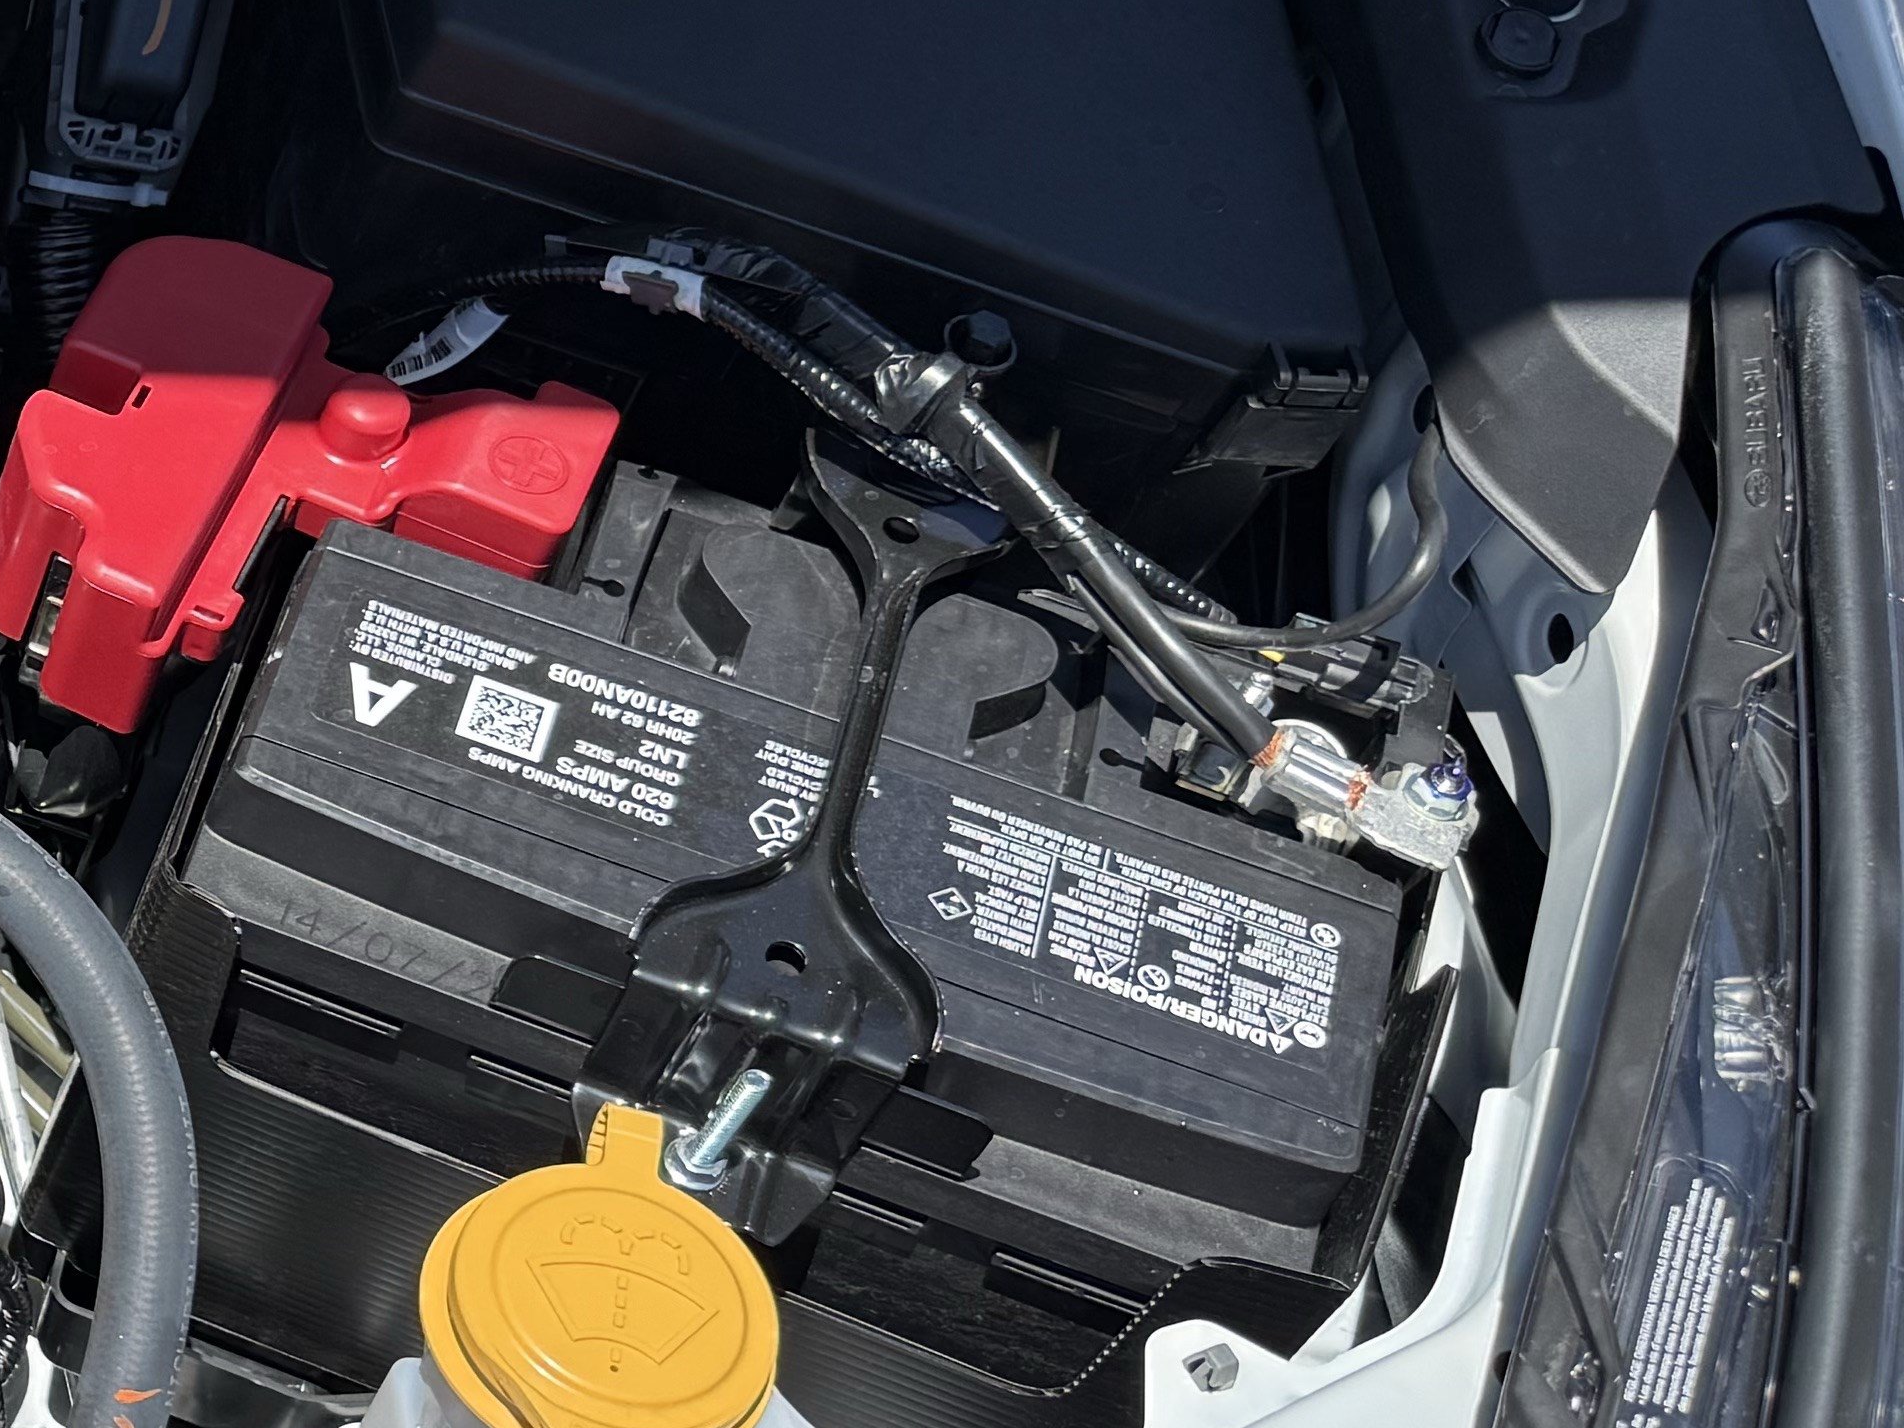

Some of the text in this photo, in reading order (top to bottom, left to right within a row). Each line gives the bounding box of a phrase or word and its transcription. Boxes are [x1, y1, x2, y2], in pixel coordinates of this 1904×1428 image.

[368, 600, 536, 664] AND IMPORTED MATERIALS
[387, 619, 421, 637] WITH
[398, 634, 416, 647] WI
[424, 630, 462, 651] U.S.A.
[462, 644, 478, 656] IN
[348, 640, 454, 683] DISTRIBUTED BY:
[478, 649, 516, 670] MADE
[350, 663, 415, 725] A
[549, 664, 700, 726] 82110AN00B
[591, 701, 695, 745] 20HR 62 AH
[574, 739, 681, 785] GROUP SIZE
[638, 740, 687, 768] LN2
[468, 747, 669, 826] COLD CRANKING AMPS
[556, 757, 675, 809] 620 AMPS
[1029, 833, 1044, 846] OR
[1044, 840, 1060, 852] TIP
[1061, 845, 1083, 860] NOT
[1083, 853, 1099, 865] DO
[1172, 884, 1186, 896] OF
[1187, 889, 1221, 908] REACH
[1014, 895, 1040, 911] HELP
[1222, 901, 1241, 915] THE
[1243, 909, 1256, 920] OF
[1257, 913, 1279, 928] OUT
[1279, 922, 1306, 937] KEEP
[974, 928, 1030, 956] FLUSH EYES
[1075, 966, 1267, 1045] DANGER/POISON
[1232, 985, 1327, 1026] EXPLOSIVE GASES
[1228, 1007, 1267, 1027] SHIELD
